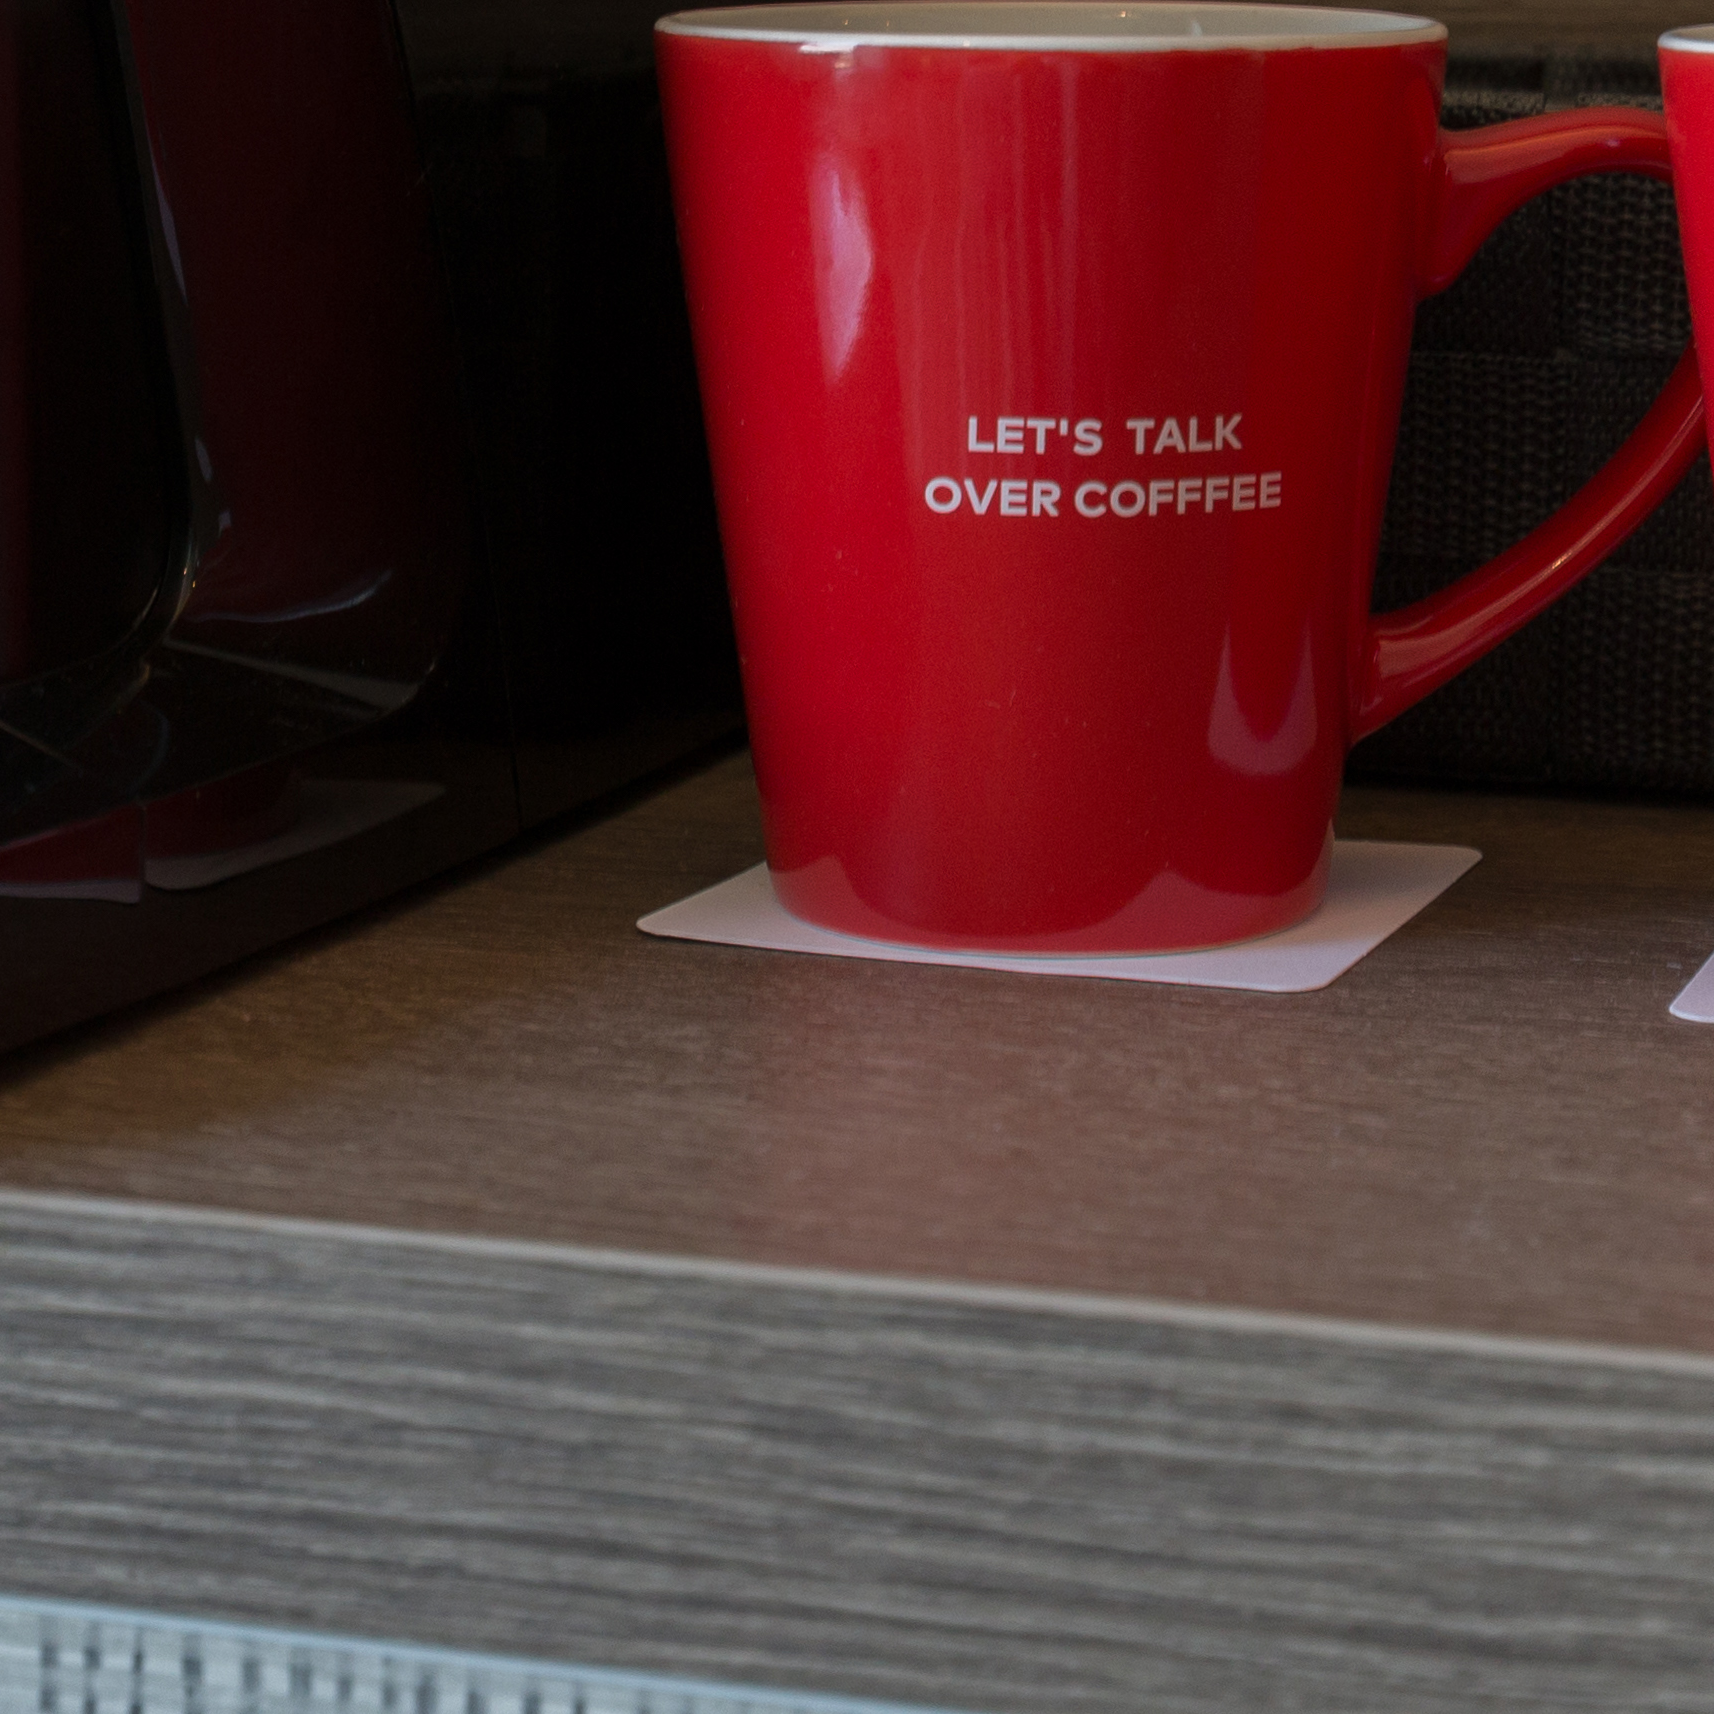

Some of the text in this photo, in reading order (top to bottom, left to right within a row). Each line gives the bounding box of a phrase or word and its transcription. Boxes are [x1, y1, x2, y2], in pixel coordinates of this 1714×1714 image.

[967, 413, 1243, 456] LET'S TALK
[924, 471, 1282, 518] OVER COFFFEE
